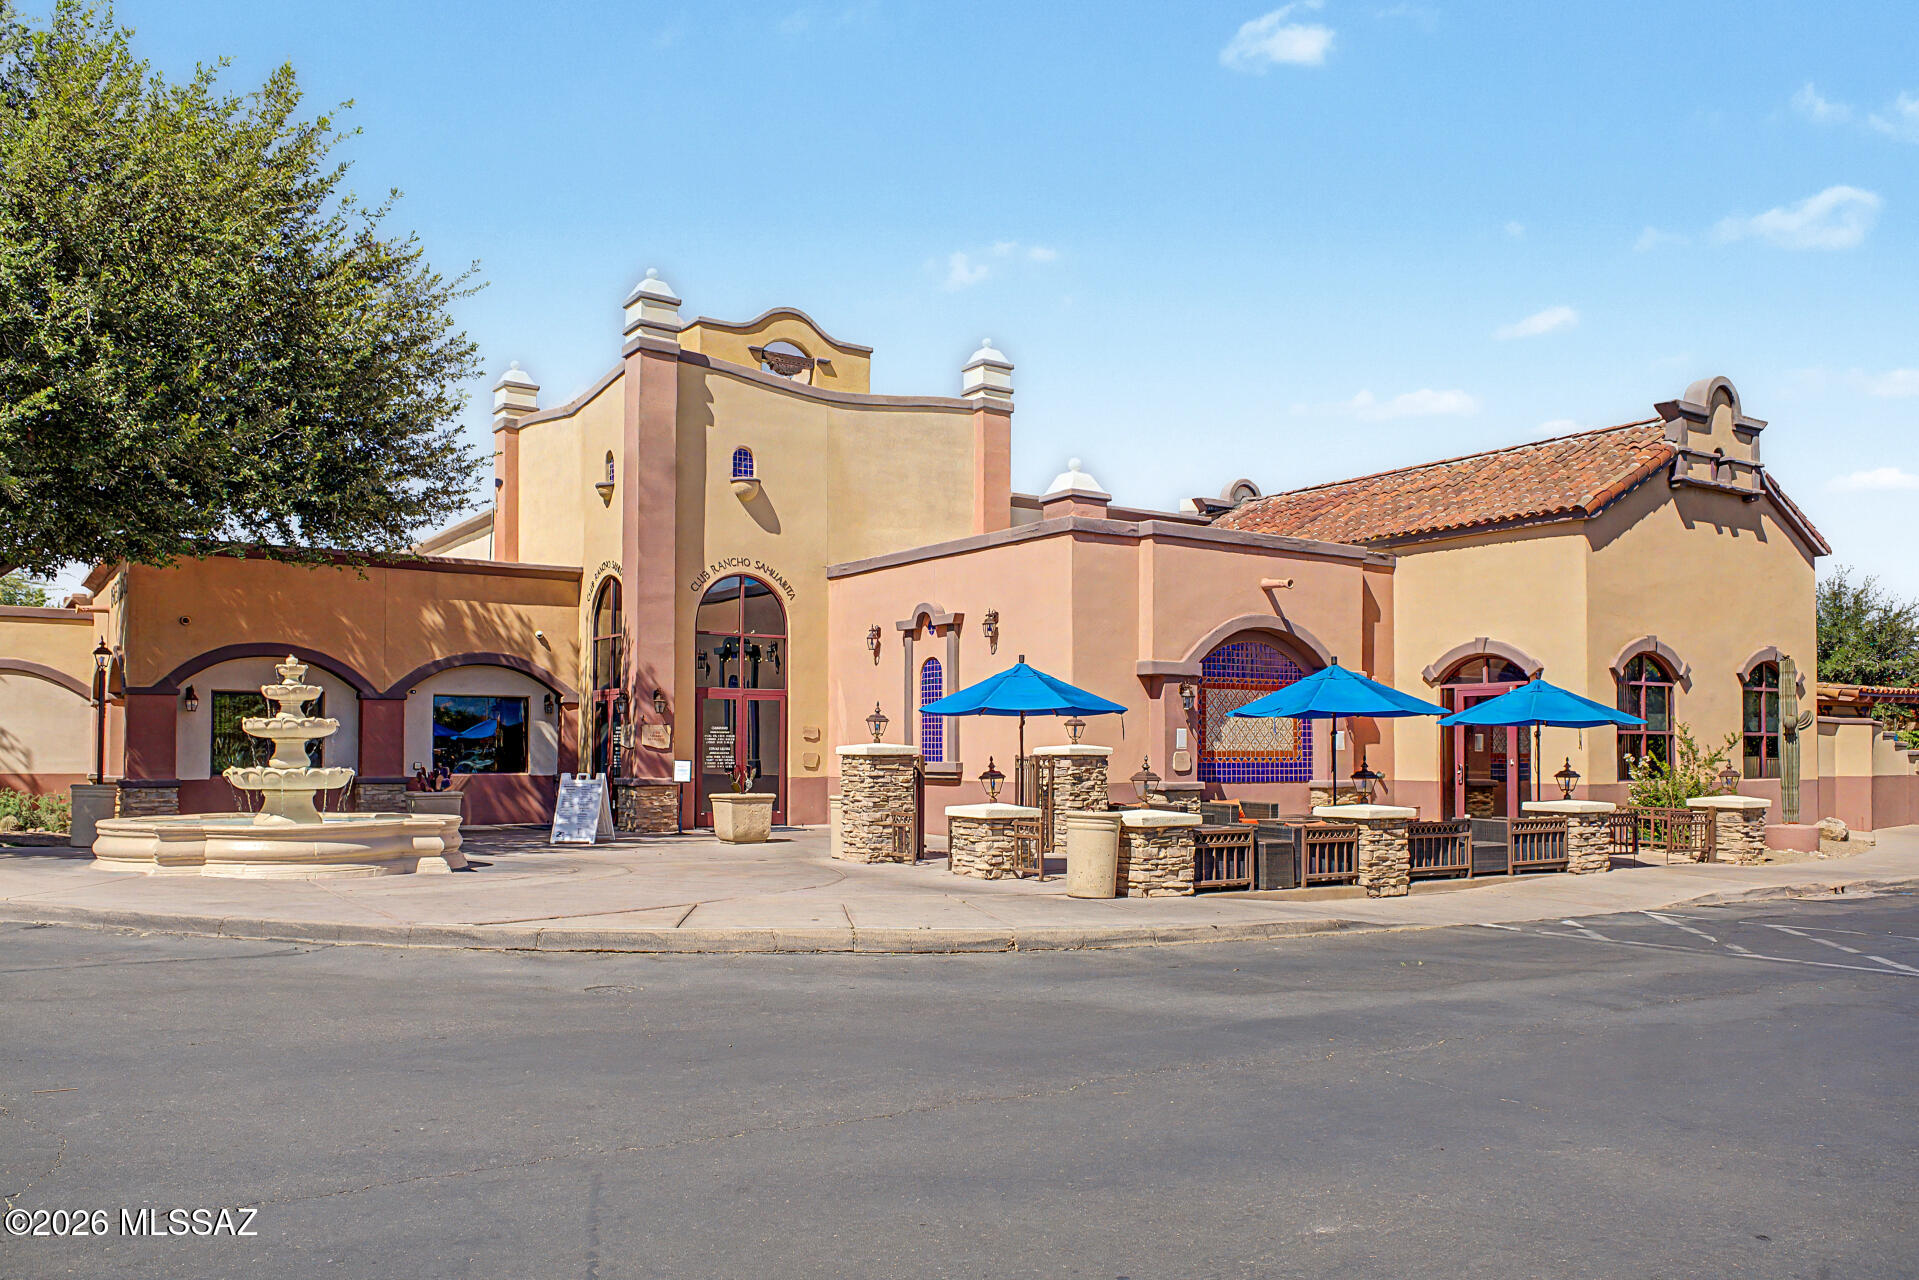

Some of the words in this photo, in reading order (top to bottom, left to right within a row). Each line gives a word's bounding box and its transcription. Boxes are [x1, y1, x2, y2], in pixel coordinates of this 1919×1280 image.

[690, 570, 711, 592] CLUB
[710, 557, 751, 574] RANCHO
[753, 560, 796, 601] SAHUARITA
